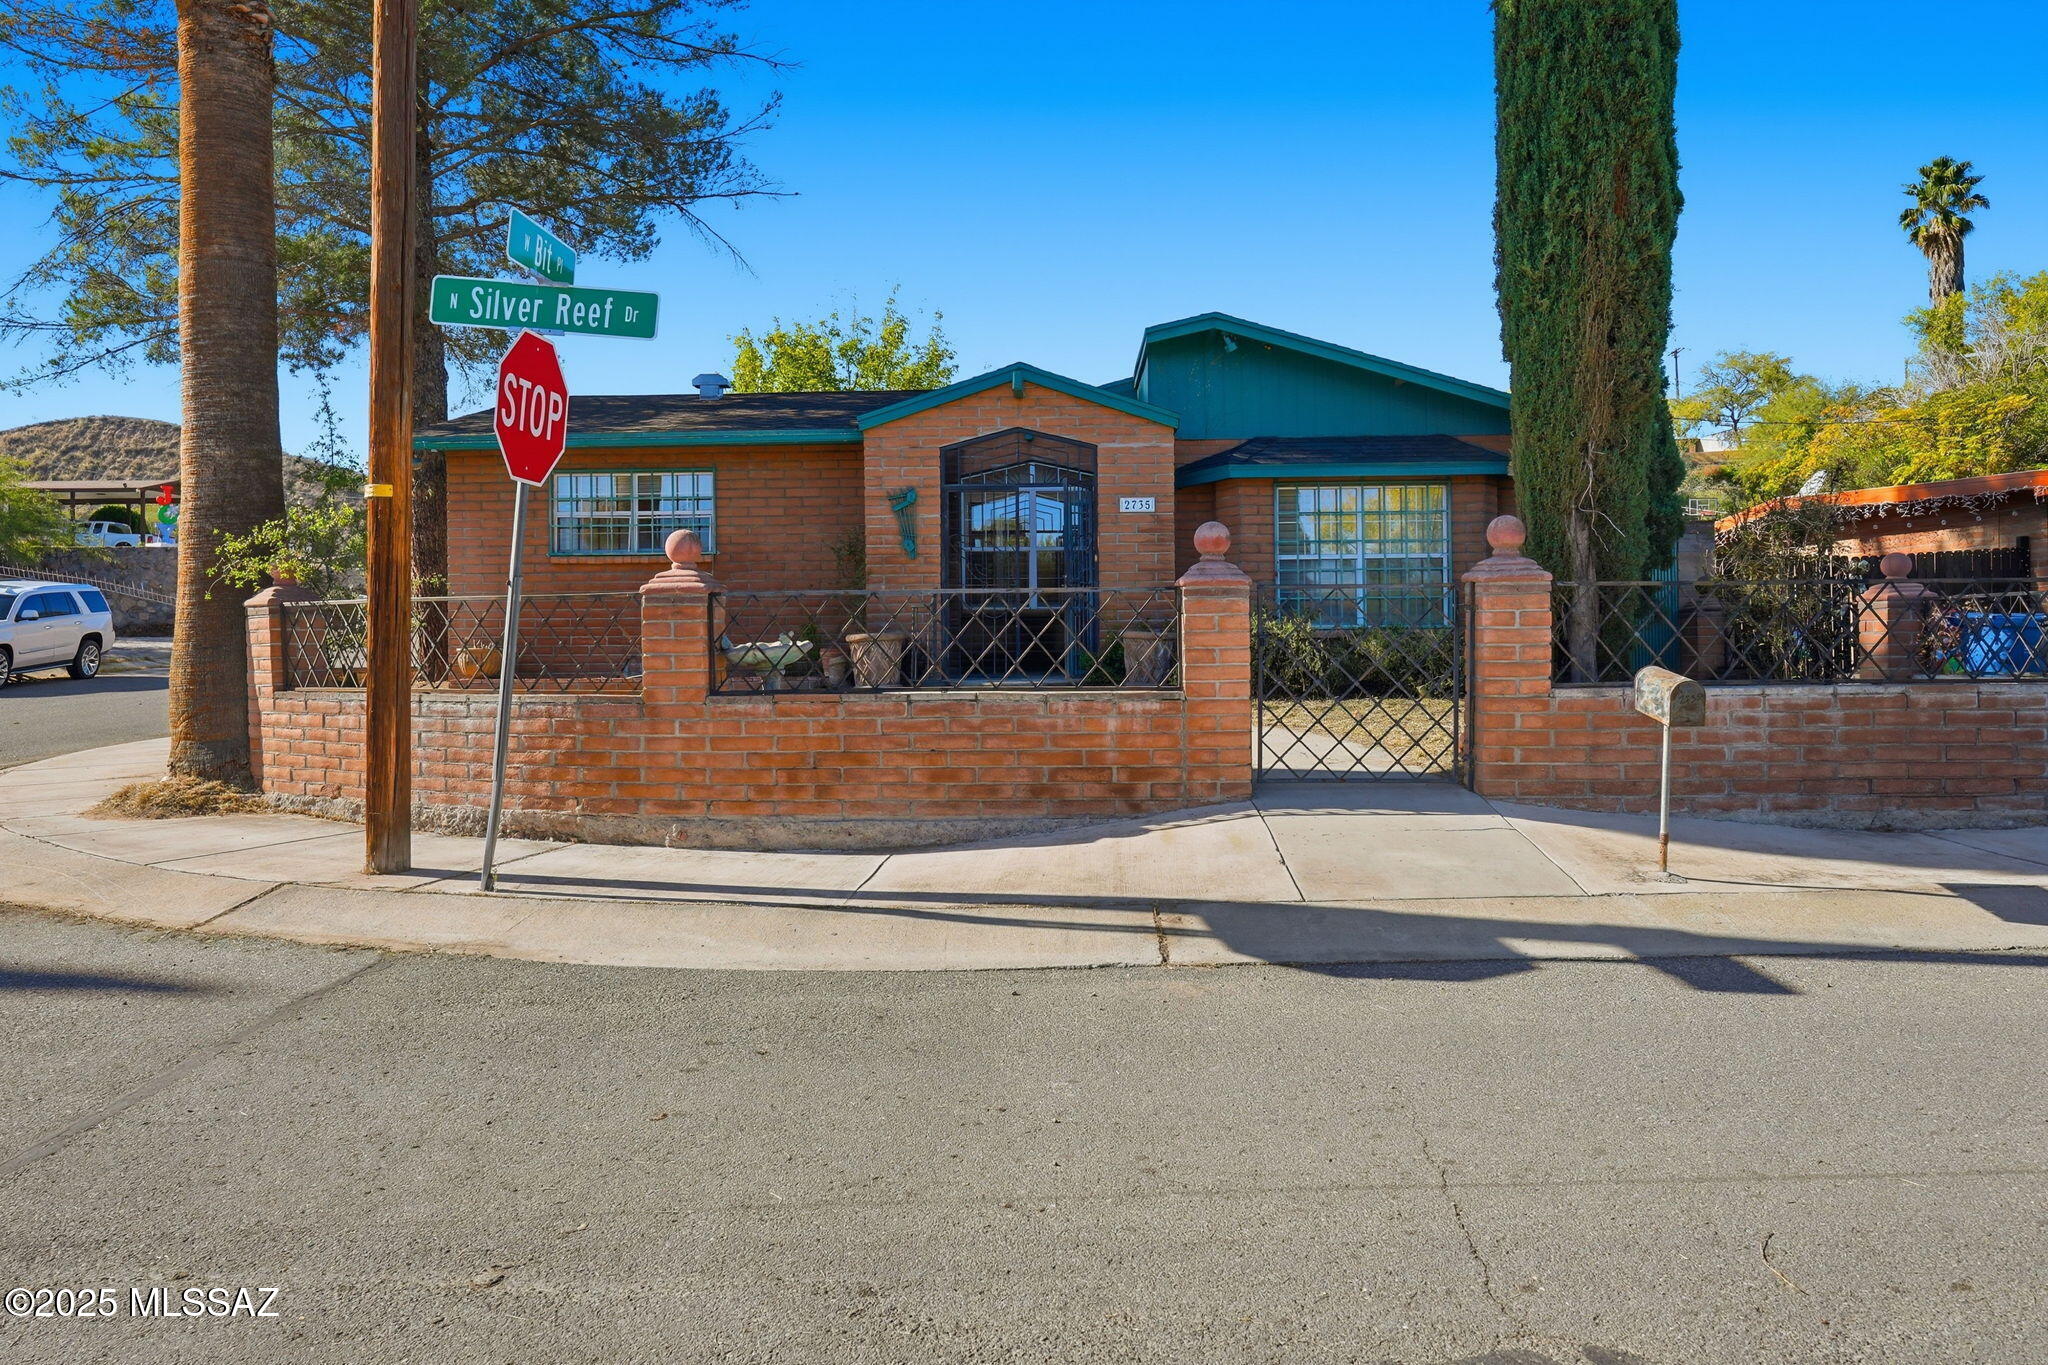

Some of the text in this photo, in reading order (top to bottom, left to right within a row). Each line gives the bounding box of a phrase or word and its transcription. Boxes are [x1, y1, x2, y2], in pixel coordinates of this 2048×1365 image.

[524, 233, 531, 252] N
[534, 233, 552, 274] Bit
[450, 286, 639, 328] N Silver Reef Dr
[501, 372, 563, 440] STOP
[1124, 500, 1151, 510] 2735
